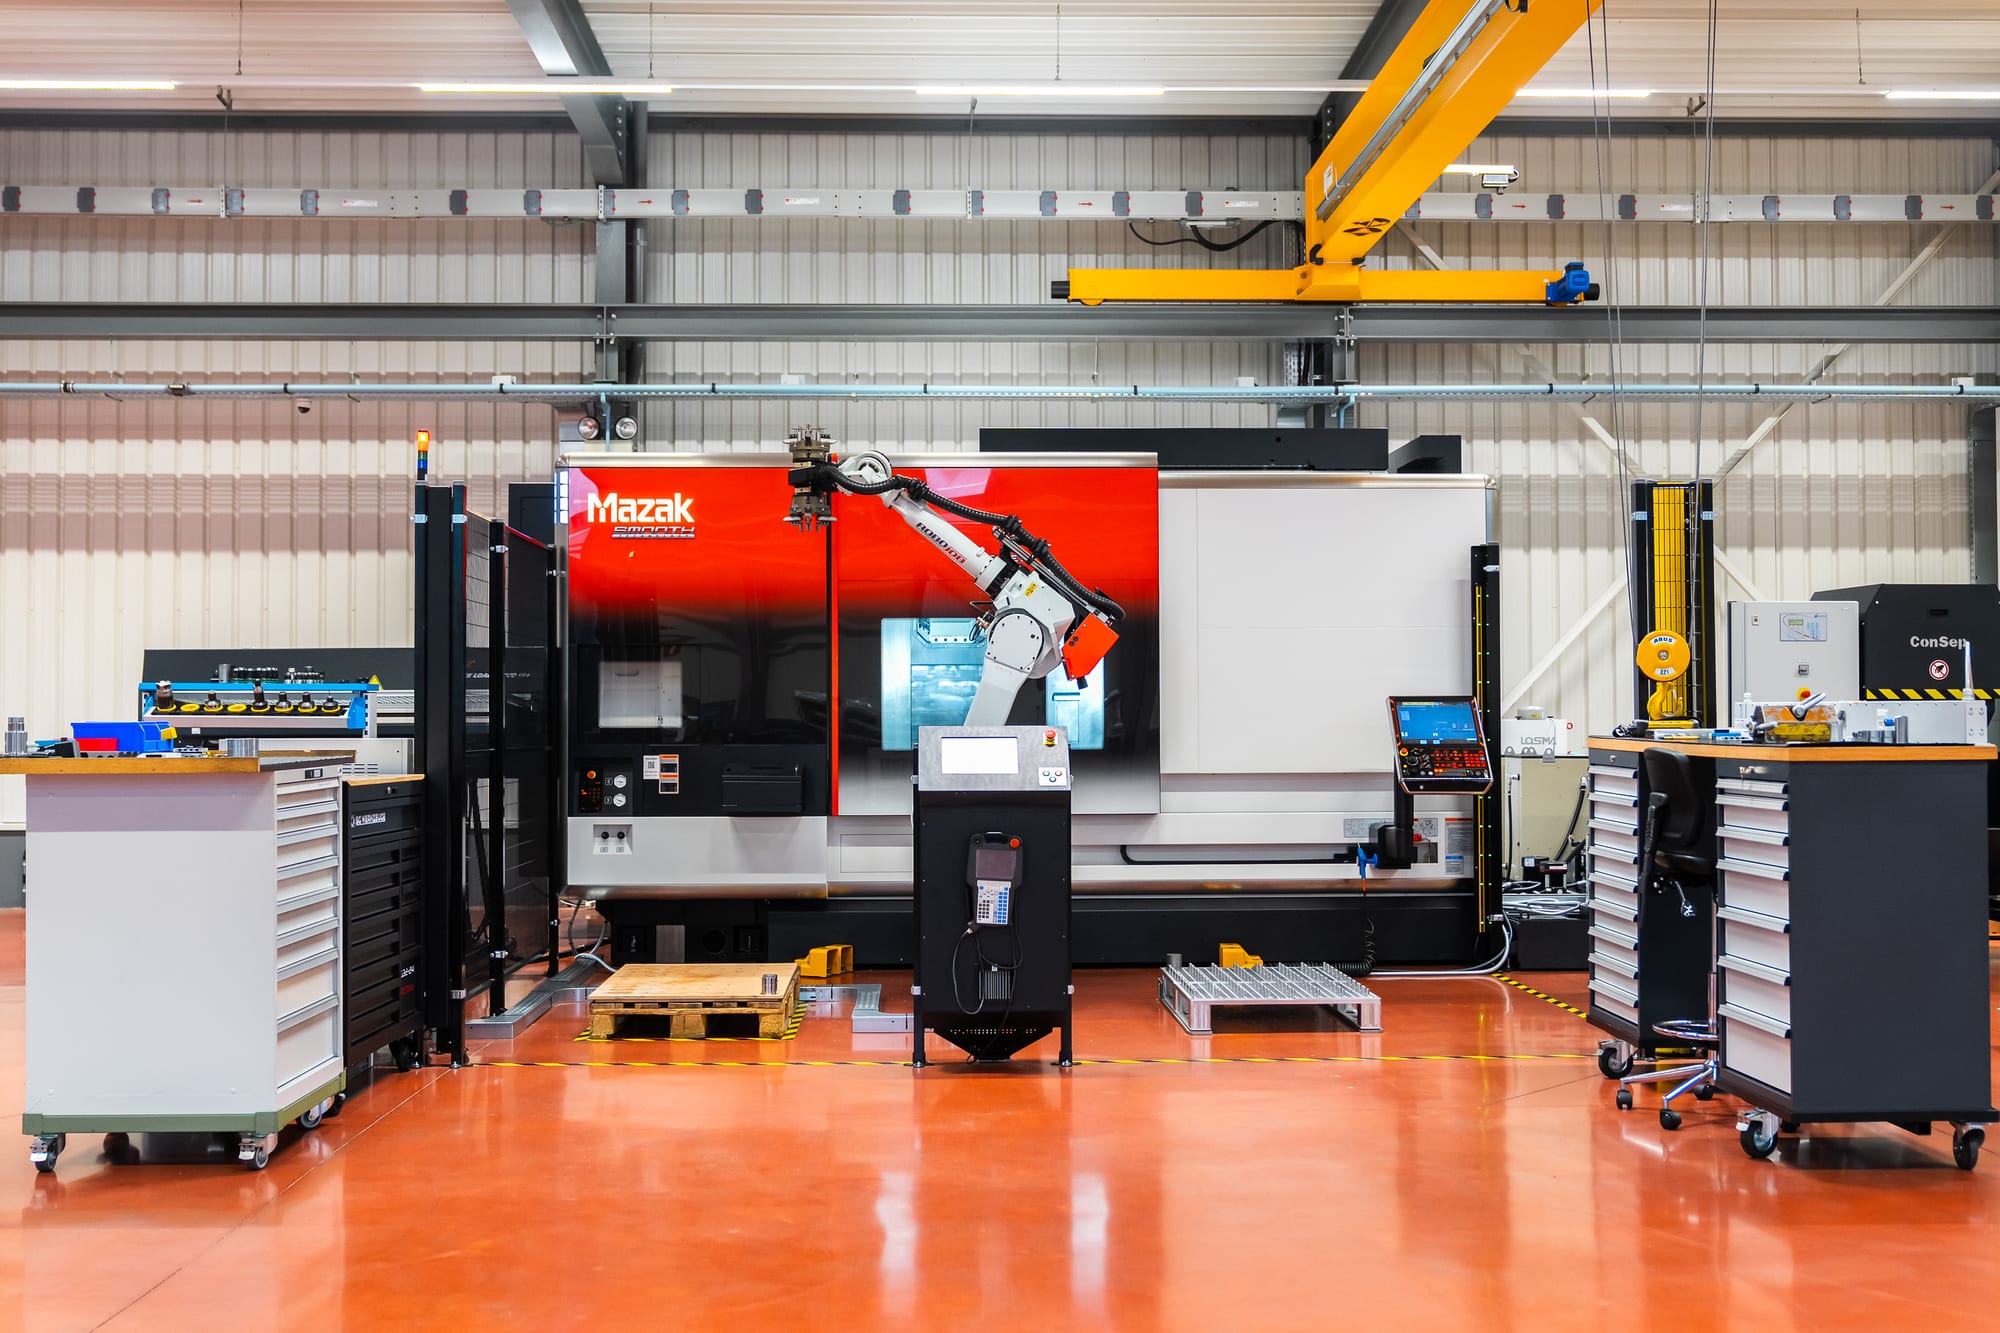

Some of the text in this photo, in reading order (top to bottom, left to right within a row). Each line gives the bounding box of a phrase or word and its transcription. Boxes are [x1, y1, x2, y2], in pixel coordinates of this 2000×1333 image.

[587, 492, 695, 523] Mazak
[614, 526, 695, 535] SMOOTH
[1910, 635, 1966, 650] ConSep
[1521, 736, 1556, 745] LOSMA
